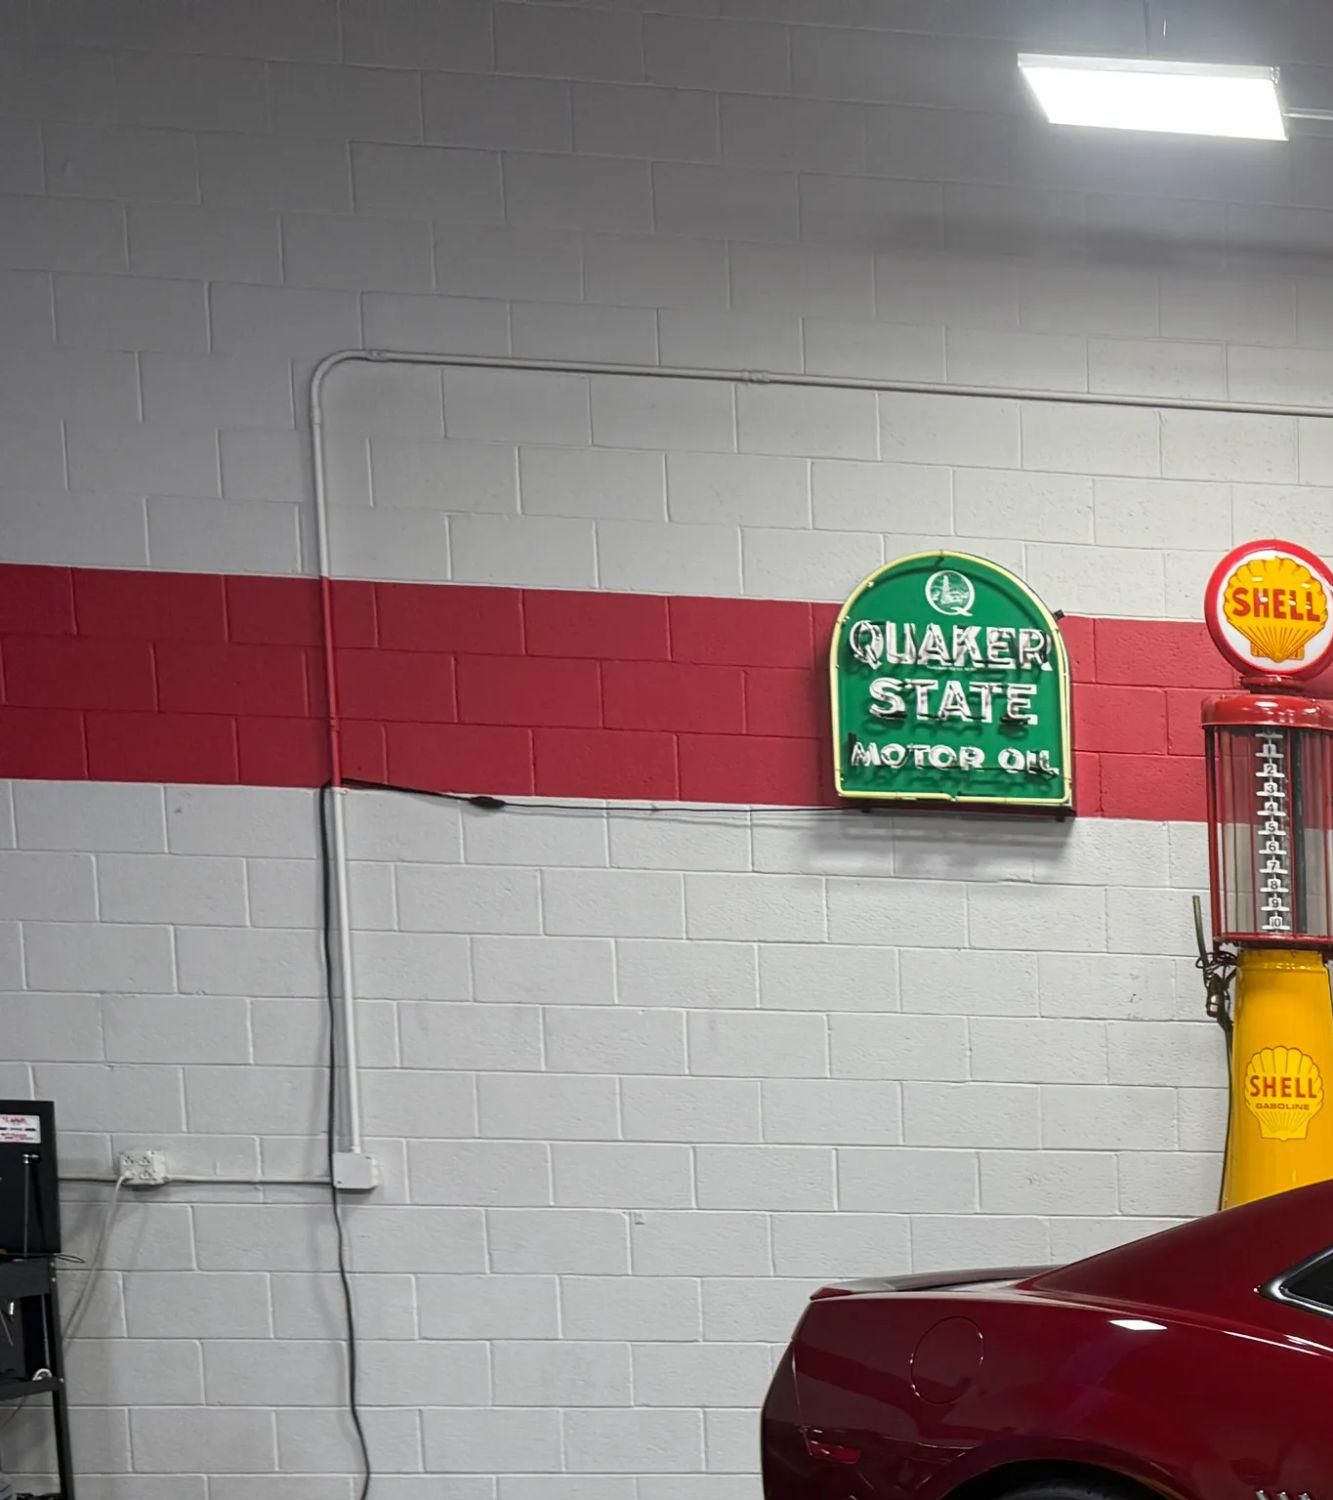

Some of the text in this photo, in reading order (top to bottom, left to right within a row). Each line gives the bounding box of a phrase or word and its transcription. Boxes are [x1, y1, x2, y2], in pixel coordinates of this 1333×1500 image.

[1231, 586, 1321, 622] SHELL
[849, 619, 1053, 671] QUAKER
[869, 677, 1038, 725] STATE
[850, 742, 1060, 776] MOTOR OIL
[1266, 764, 1274, 774] 2
[1266, 784, 1275, 793] 3
[1266, 803, 1274, 812] 4
[1268, 823, 1276, 832] 5
[1268, 842, 1277, 851] 6
[1269, 861, 1277, 870] 7
[1270, 880, 1278, 890] 8
[1271, 899, 1279, 908] 9
[1271, 918, 1281, 927] 10
[1249, 1074, 1318, 1099] SHELL
[1255, 1102, 1311, 1111] GASOLINE
